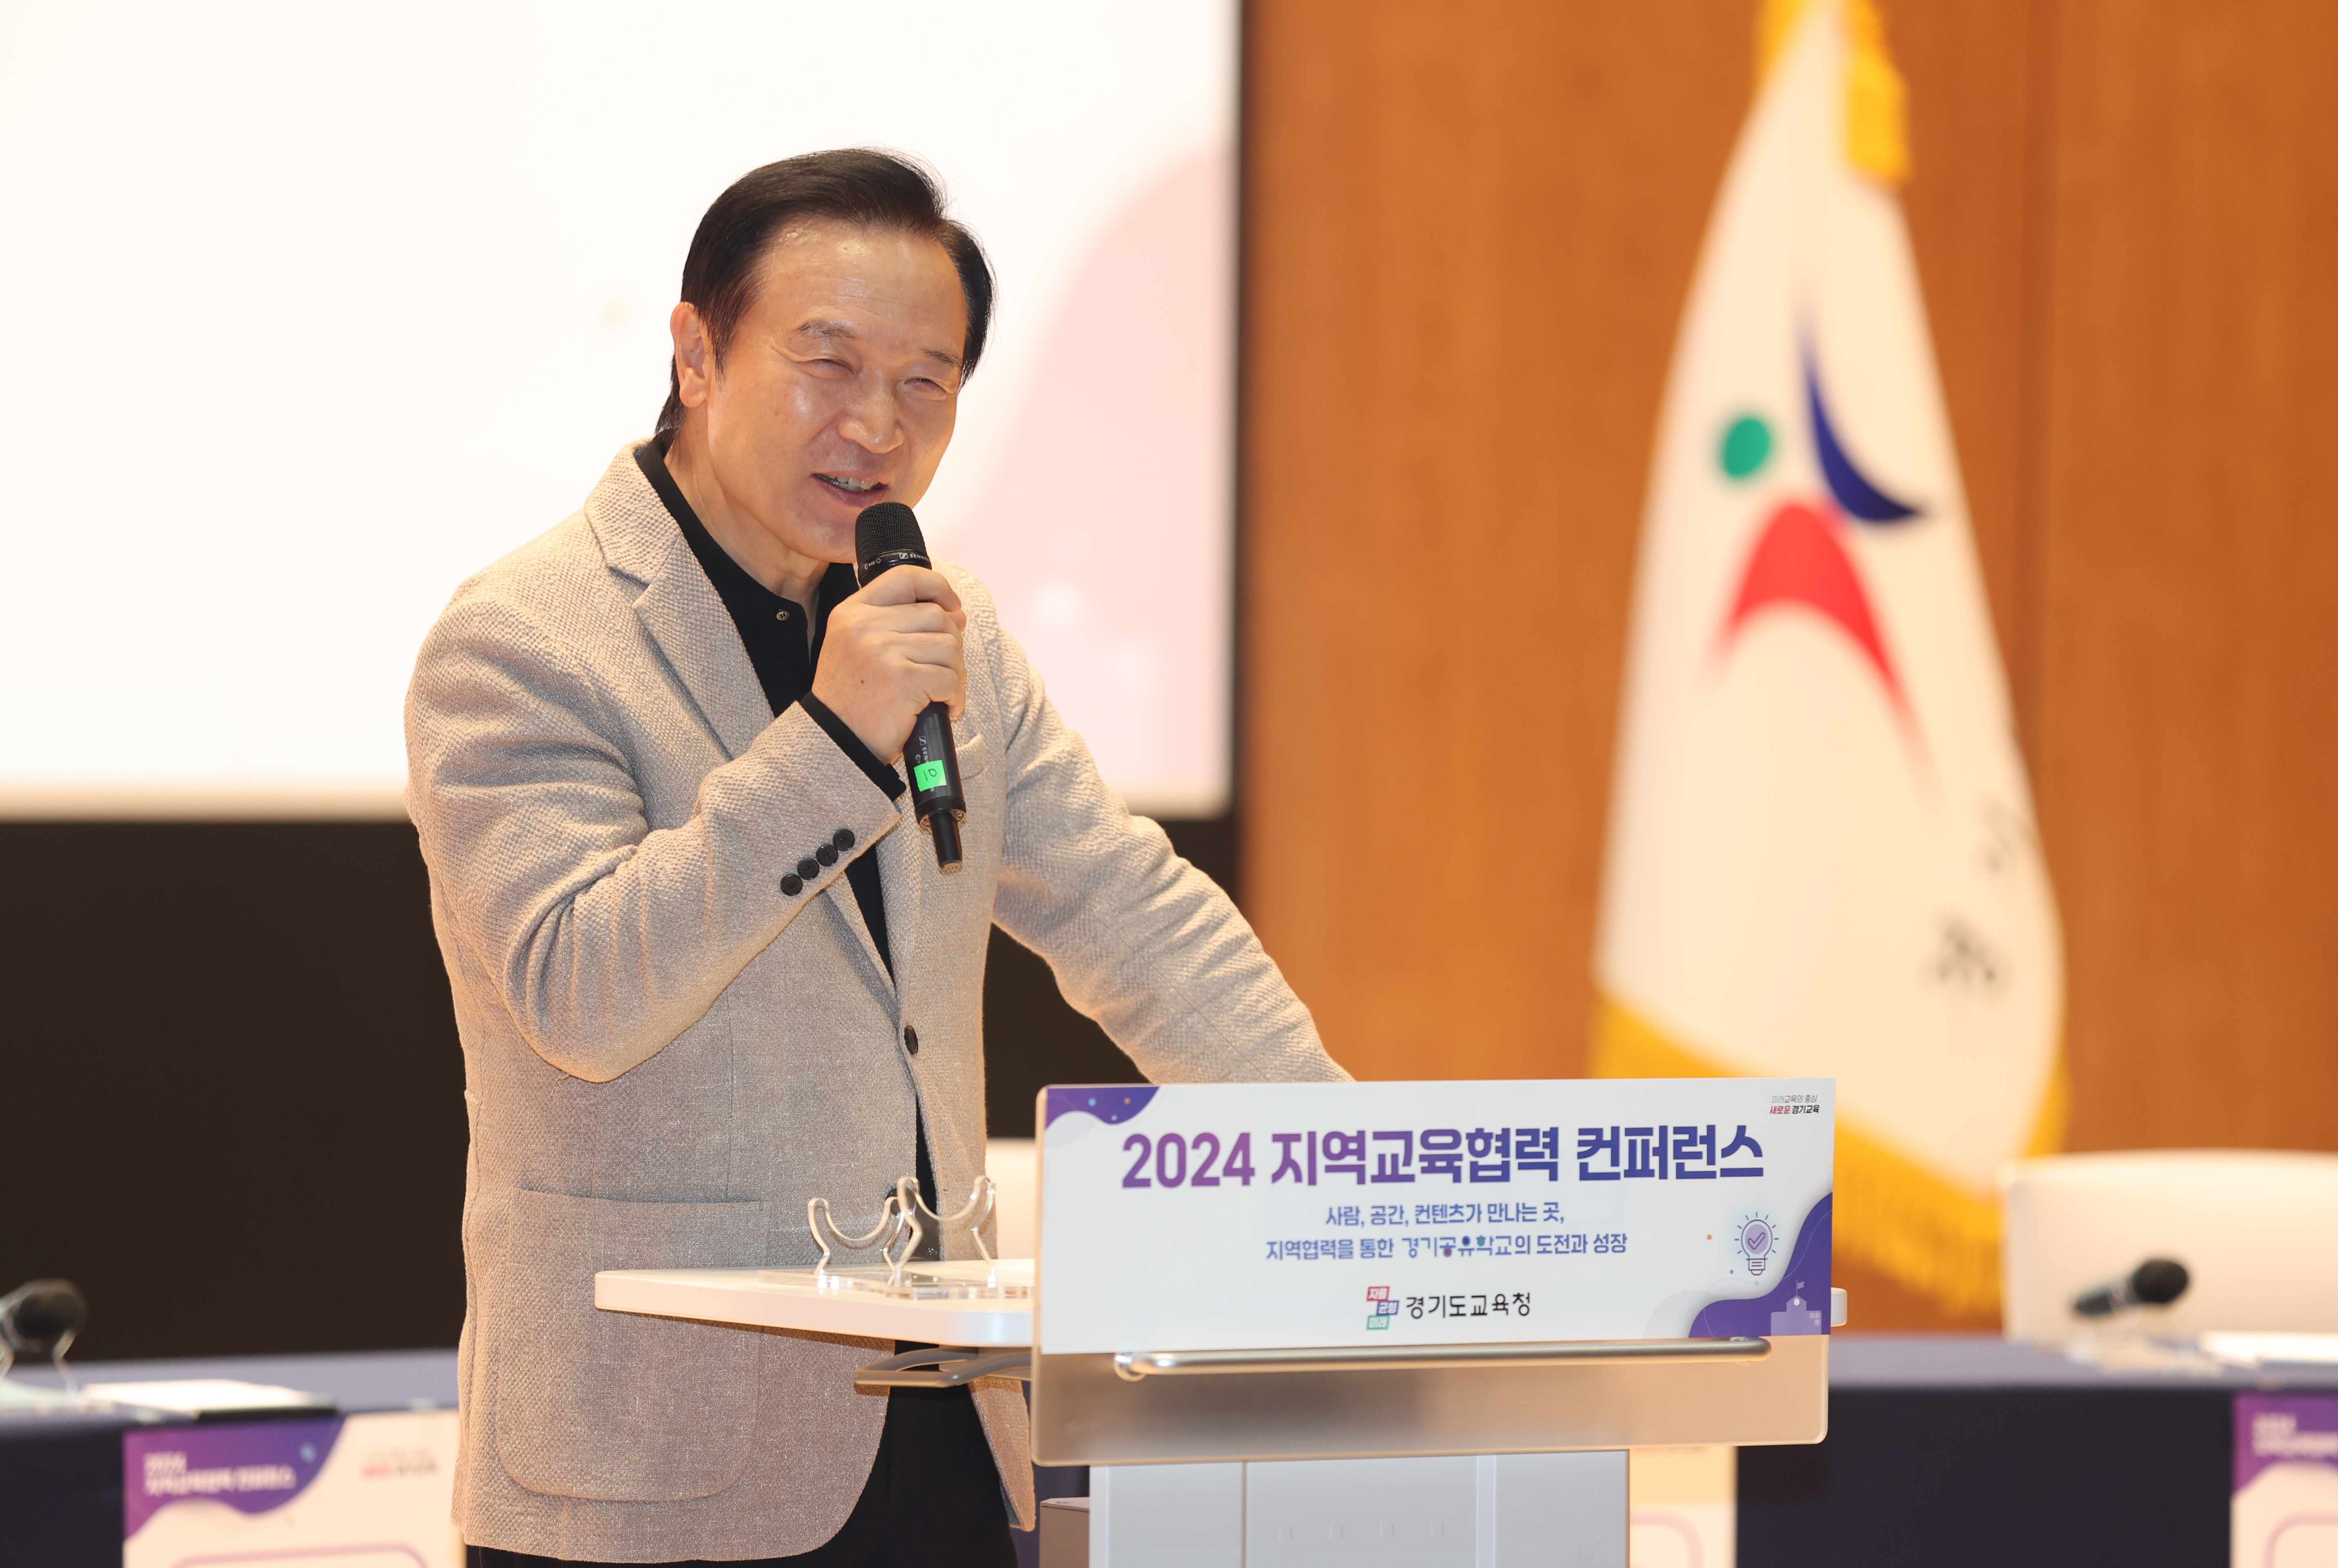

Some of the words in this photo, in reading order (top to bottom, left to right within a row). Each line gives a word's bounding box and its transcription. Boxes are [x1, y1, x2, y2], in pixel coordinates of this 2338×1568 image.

[1770, 1106, 1791, 1114] 새로운
[1792, 1105, 1820, 1114] 경기교육
[1772, 1095, 1804, 1103] 미래교육의
[1122, 1132, 1256, 1189] 2024
[1272, 1127, 1559, 1187] 지역교육협력
[1577, 1125, 1764, 1181] 컨퍼런스
[1326, 1206, 1365, 1228] 사람,
[1371, 1205, 1409, 1227] 공간,
[1415, 1204, 1483, 1225] 컨텐츠가
[1488, 1203, 1538, 1224] 만나는
[1543, 1202, 1564, 1224] 곳,
[1266, 1240, 1354, 1261] 지역협력을
[1360, 1239, 1395, 1259] 통한
[1402, 1235, 1531, 1258] 경기공유학교의
[1537, 1234, 1588, 1255] 도전과
[1593, 1233, 1628, 1254] 성장
[1406, 1293, 1531, 1320] 경기도교육청
